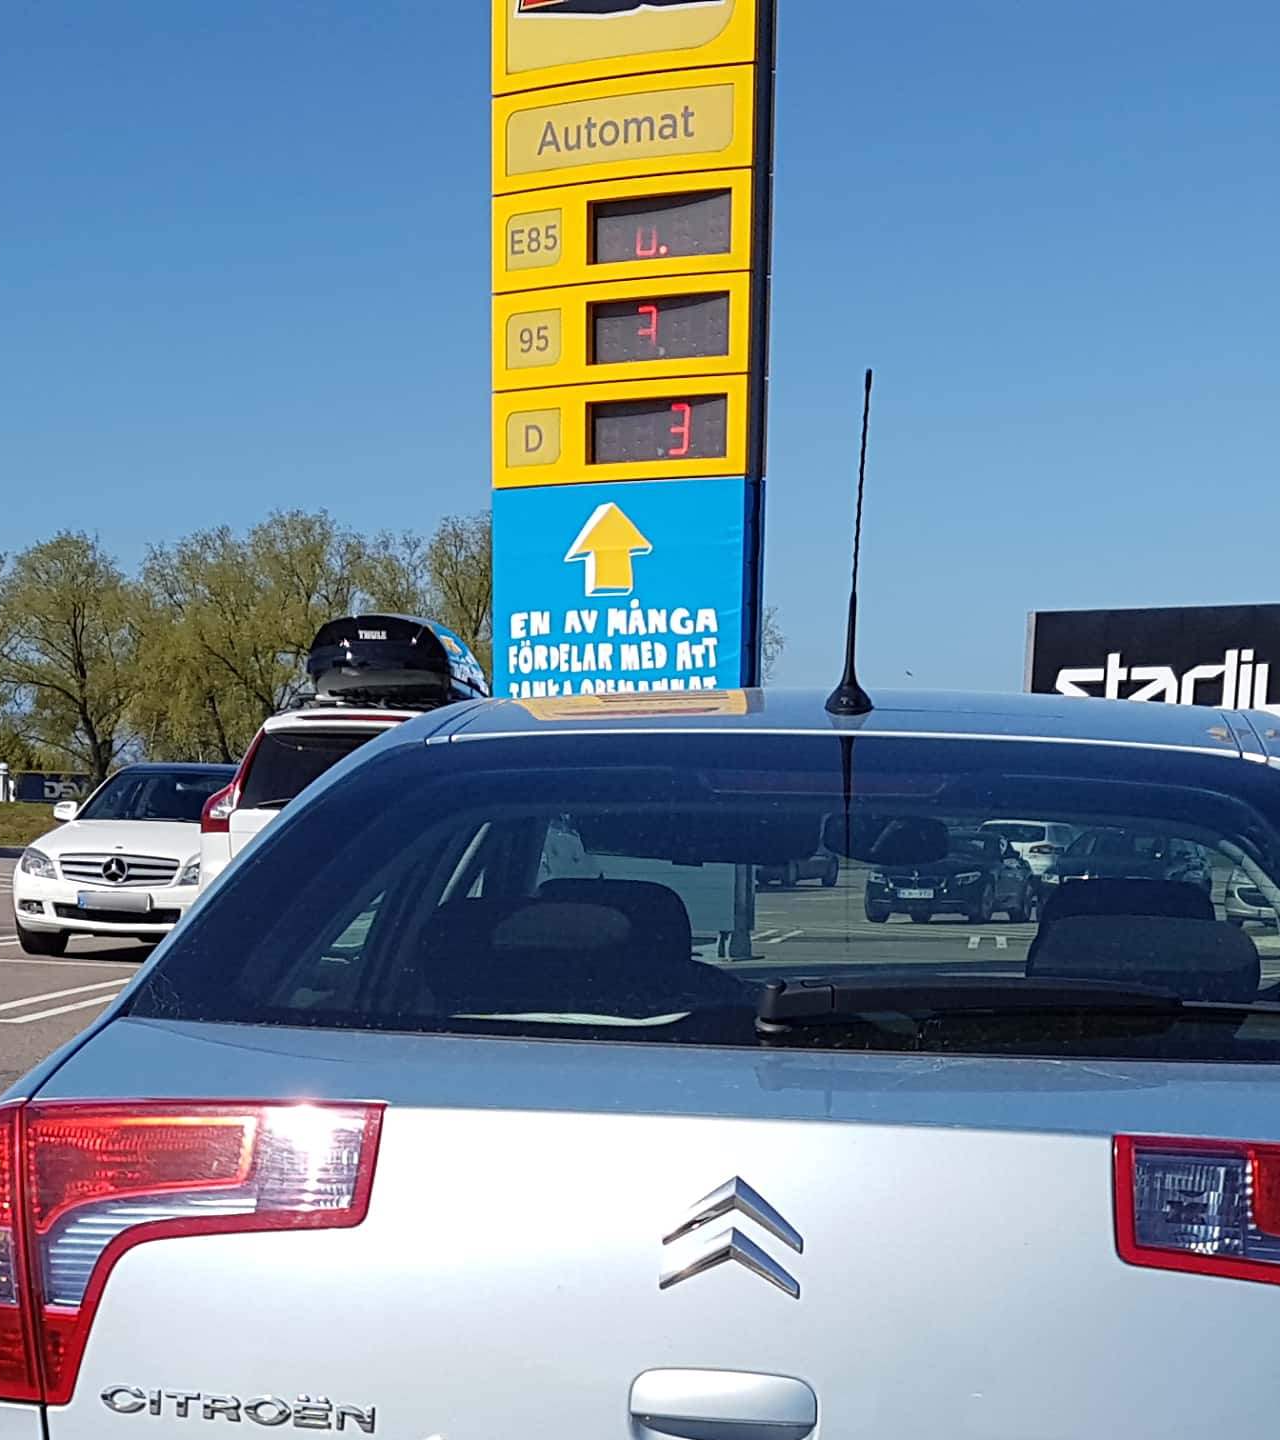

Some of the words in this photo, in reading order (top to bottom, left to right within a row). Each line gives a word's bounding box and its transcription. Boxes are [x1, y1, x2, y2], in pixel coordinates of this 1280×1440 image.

[537, 105, 695, 156] Automat
[510, 224, 558, 256] E85
[519, 325, 549, 353] 95
[524, 424, 543, 453] D
[669, 402, 691, 455] 3
[510, 610, 551, 639] EN
[564, 609, 598, 635] AV
[607, 598, 718, 637] MÅNGA
[508, 641, 613, 675] FÖRDELAR
[620, 640, 667, 672] MED
[676, 637, 718, 671] ATT
[100, 1383, 376, 1435] CITROËN
